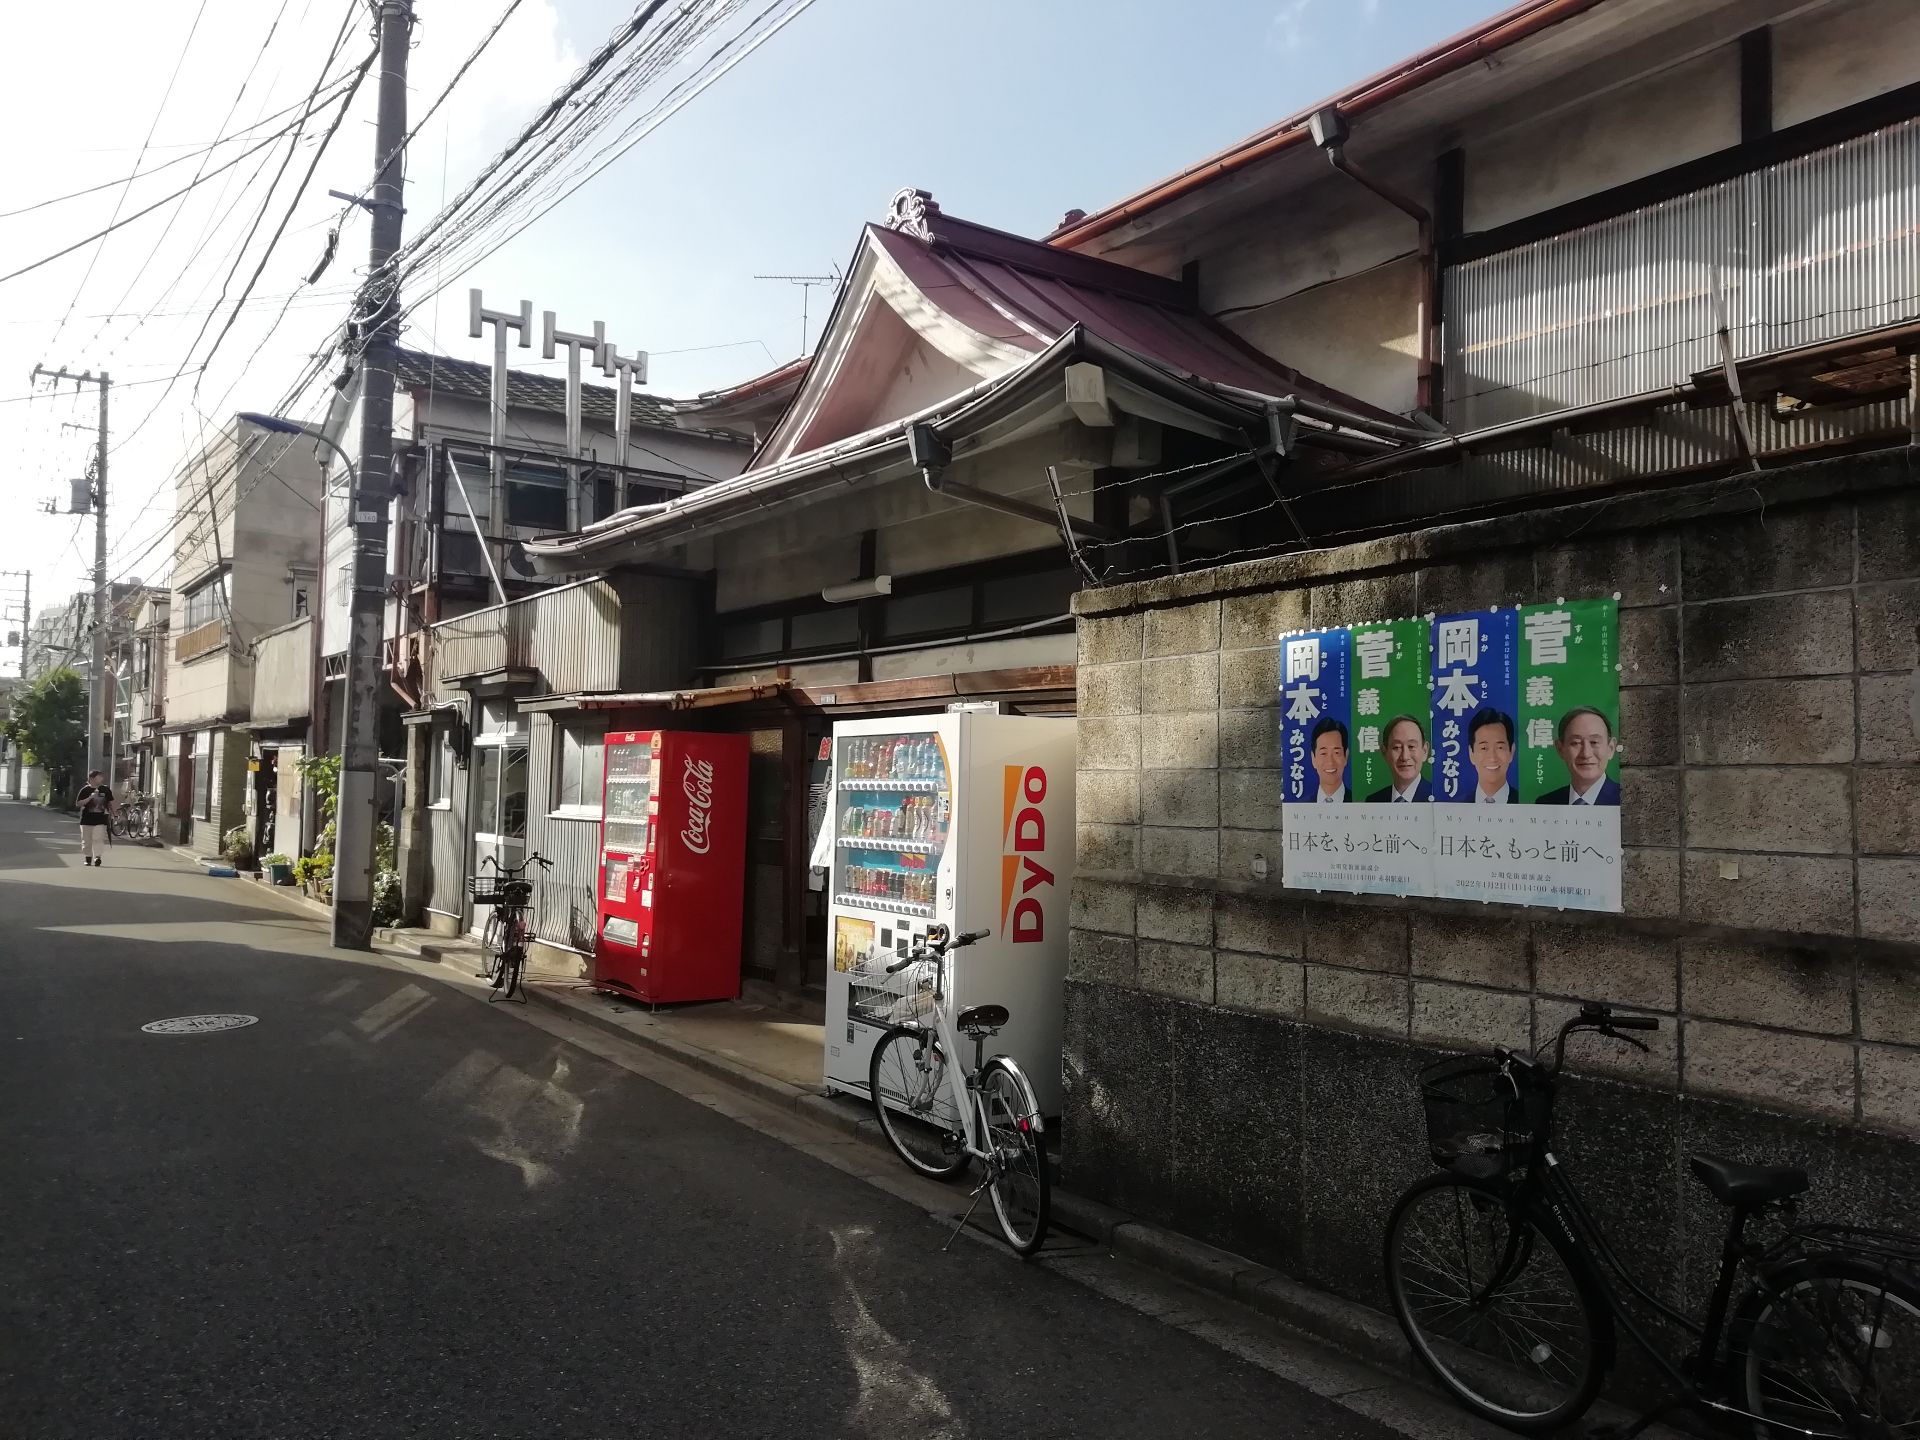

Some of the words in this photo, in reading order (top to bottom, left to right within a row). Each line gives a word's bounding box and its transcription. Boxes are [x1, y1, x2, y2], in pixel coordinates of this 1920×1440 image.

[1481, 633, 1489, 652] おか
[1574, 624, 1584, 645] すが
[1321, 651, 1328, 668] おか
[1396, 642, 1403, 660] すが
[1481, 680, 1488, 699] もと
[1321, 693, 1328, 709] もと
[1536, 753, 1544, 784] よしひで
[680, 753, 714, 854] Coca-Cola
[1360, 814, 1420, 822] Meeting
[1446, 815, 1463, 823] My
[1477, 815, 1514, 823] Town
[1529, 817, 1604, 827] Meeting
[1289, 831, 1428, 855] 日本を、もっと前へ。
[1440, 835, 1615, 865] 日本を、もっと前へ。
